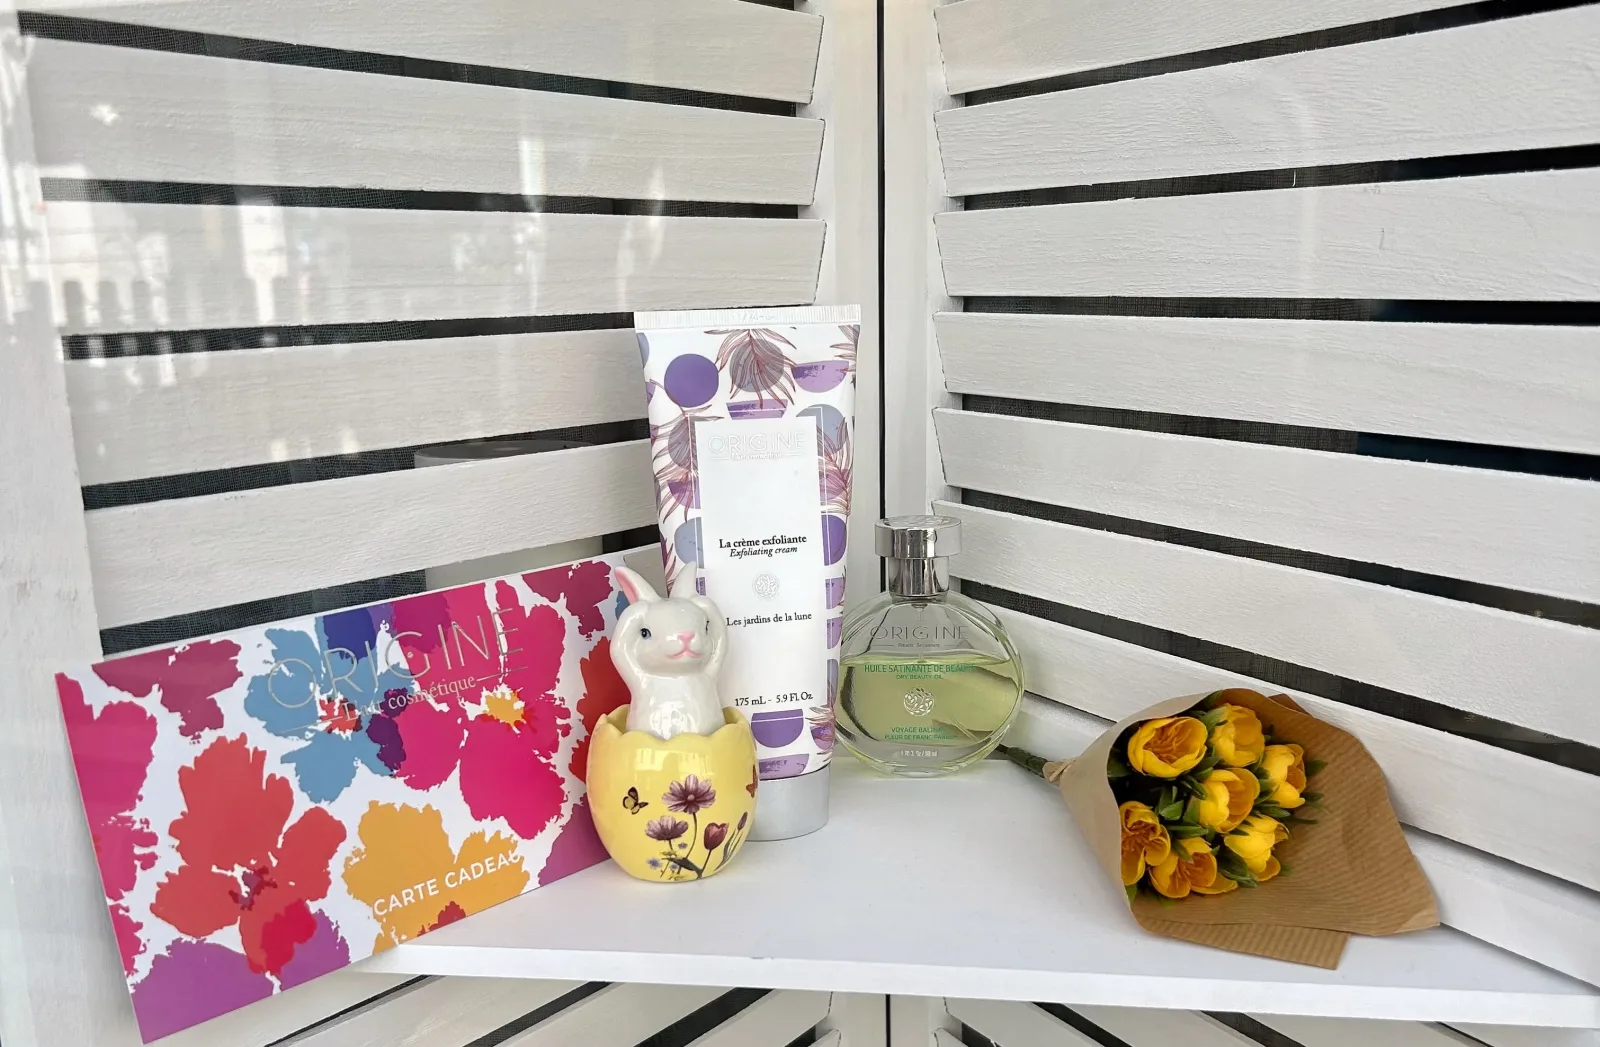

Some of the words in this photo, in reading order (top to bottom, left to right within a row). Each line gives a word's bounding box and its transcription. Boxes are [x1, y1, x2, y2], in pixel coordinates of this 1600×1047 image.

[707, 431, 805, 453] ORIGINE
[719, 538, 731, 549] La
[733, 537, 760, 548] crème
[762, 534, 807, 545] exfoliante
[729, 546, 773, 559] Exfoliating
[774, 546, 798, 554] cream
[726, 617, 742, 626] Les
[743, 614, 771, 627] jardins
[773, 613, 783, 622] de
[784, 612, 793, 621] la
[794, 611, 813, 621] lune
[869, 625, 969, 640] ORIGINE
[268, 608, 524, 709] ORIGINE
[864, 664, 887, 673] HUILE
[888, 664, 932, 673] SATINANTE
[933, 664, 944, 673] DE
[387, 674, 478, 711] cosmétique
[735, 697, 750, 706] 175
[751, 695, 767, 705] mL
[776, 693, 788, 704] 5.9
[789, 692, 799, 702] Fl.
[800, 691, 814, 701] Oz
[373, 878, 440, 916] CARTE
[445, 849, 521, 889] CADEAU
